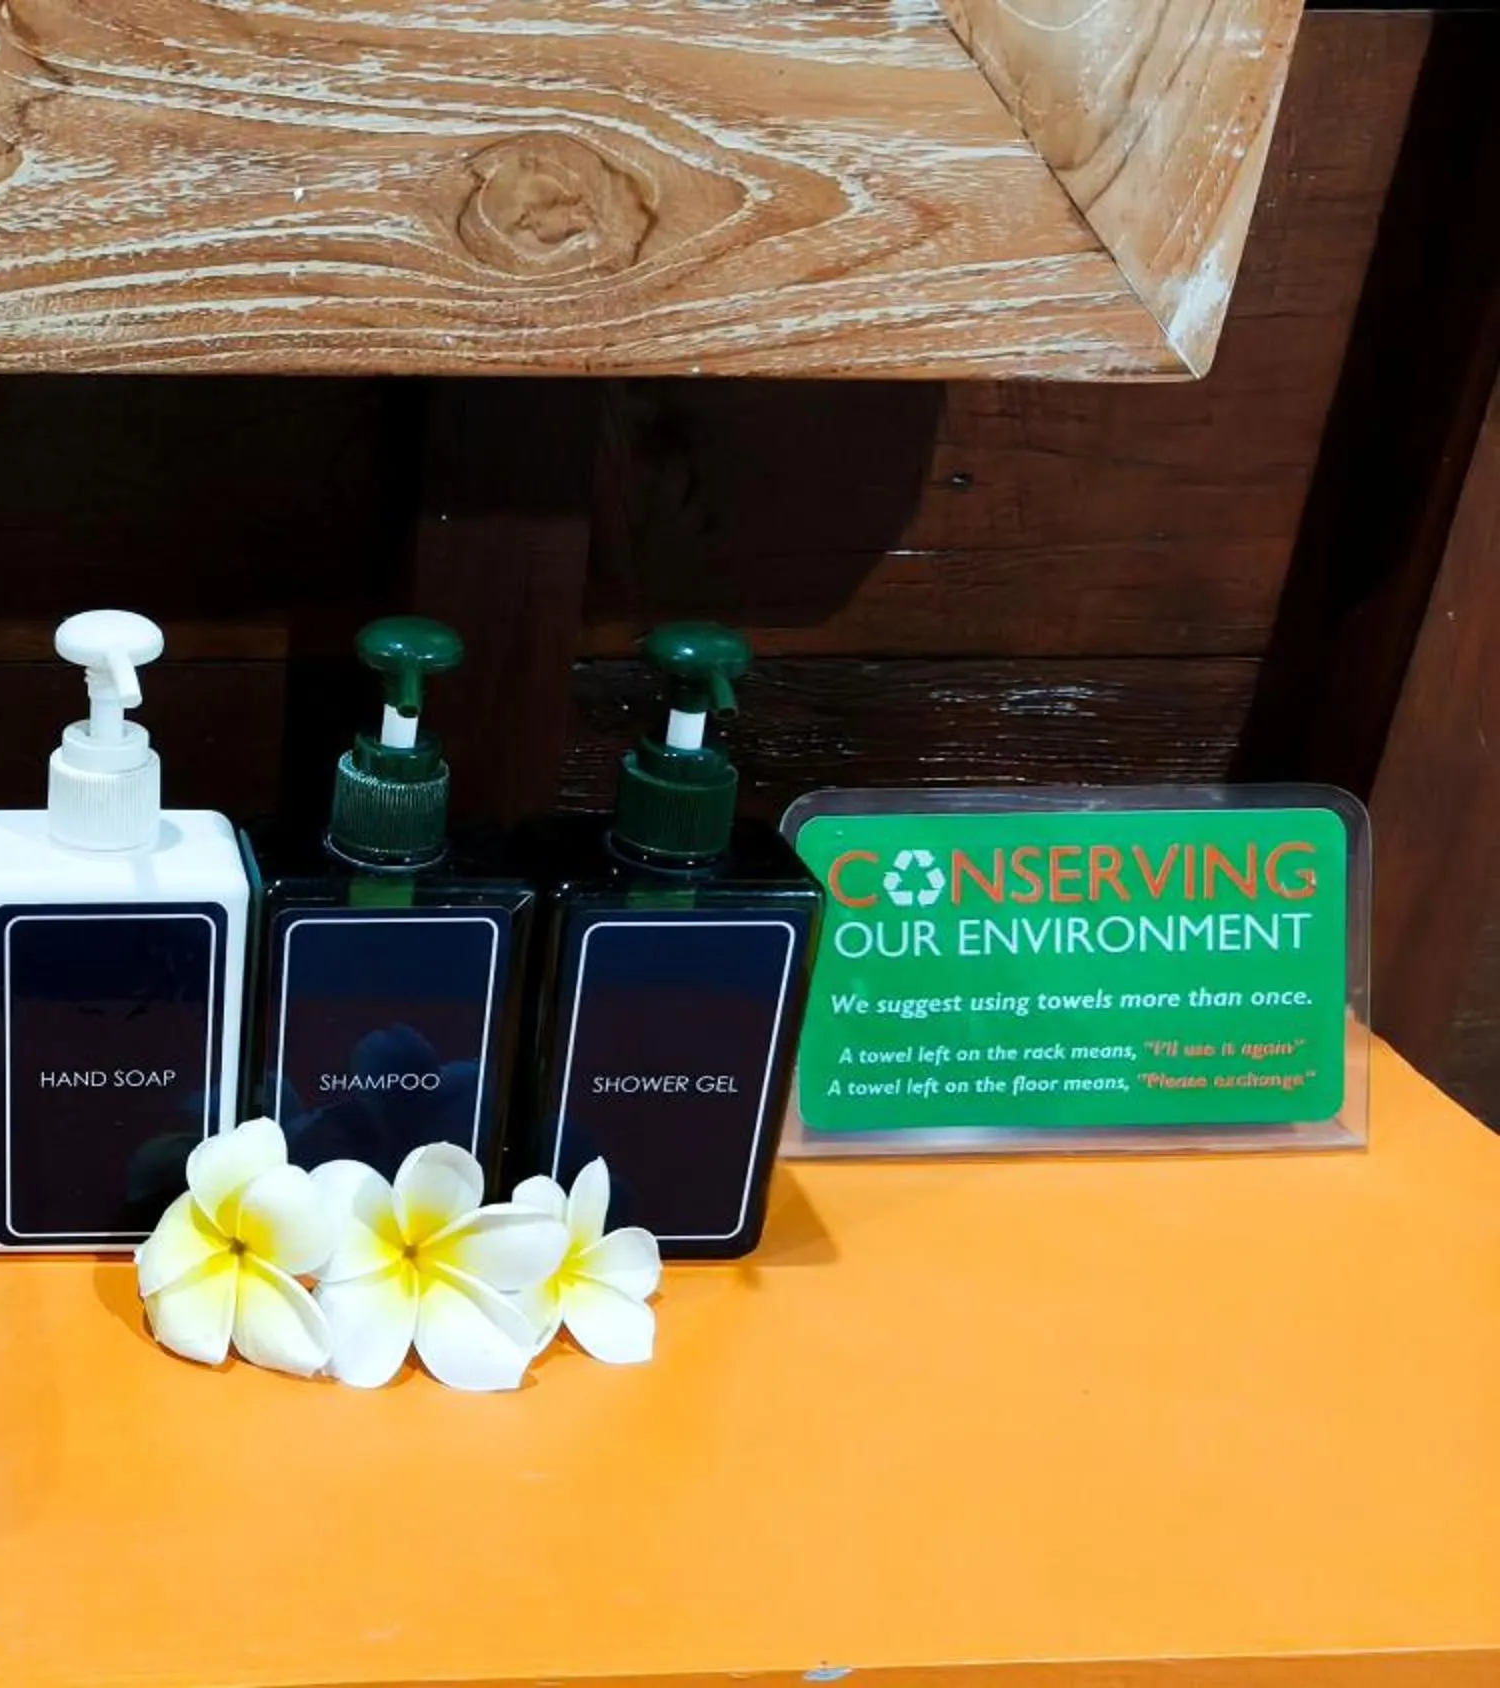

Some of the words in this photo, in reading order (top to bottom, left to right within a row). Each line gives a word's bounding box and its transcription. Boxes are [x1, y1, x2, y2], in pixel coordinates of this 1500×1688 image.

[834, 919, 941, 958] OUR
[958, 912, 1314, 957] ENVIRONMENT
[830, 994, 869, 1014] We
[876, 995, 963, 1019] suggest
[970, 992, 1030, 1017] using
[1037, 988, 1113, 1010] towels
[1119, 991, 1181, 1008] more
[1188, 987, 1242, 1007] than
[1250, 990, 1313, 1006] once.
[838, 1047, 853, 1064] A
[858, 1046, 913, 1063] towel
[918, 1045, 951, 1066] left
[956, 1049, 981, 1061] on
[987, 1045, 1018, 1061] the
[1023, 1043, 1066, 1060] rack
[1070, 1047, 1137, 1061] means,
[40, 1071, 107, 1088] HAND
[113, 1069, 177, 1087] SOAP
[319, 1073, 441, 1091] SHAMPOO
[592, 1075, 690, 1093] SHOWER
[695, 1075, 739, 1093] GEL
[827, 1079, 841, 1096] A
[848, 1078, 901, 1095] towel
[907, 1076, 939, 1099] left
[944, 1080, 970, 1093] on
[975, 1077, 1007, 1092] the
[1012, 1075, 1058, 1096] floor
[1063, 1077, 1130, 1092] means,
